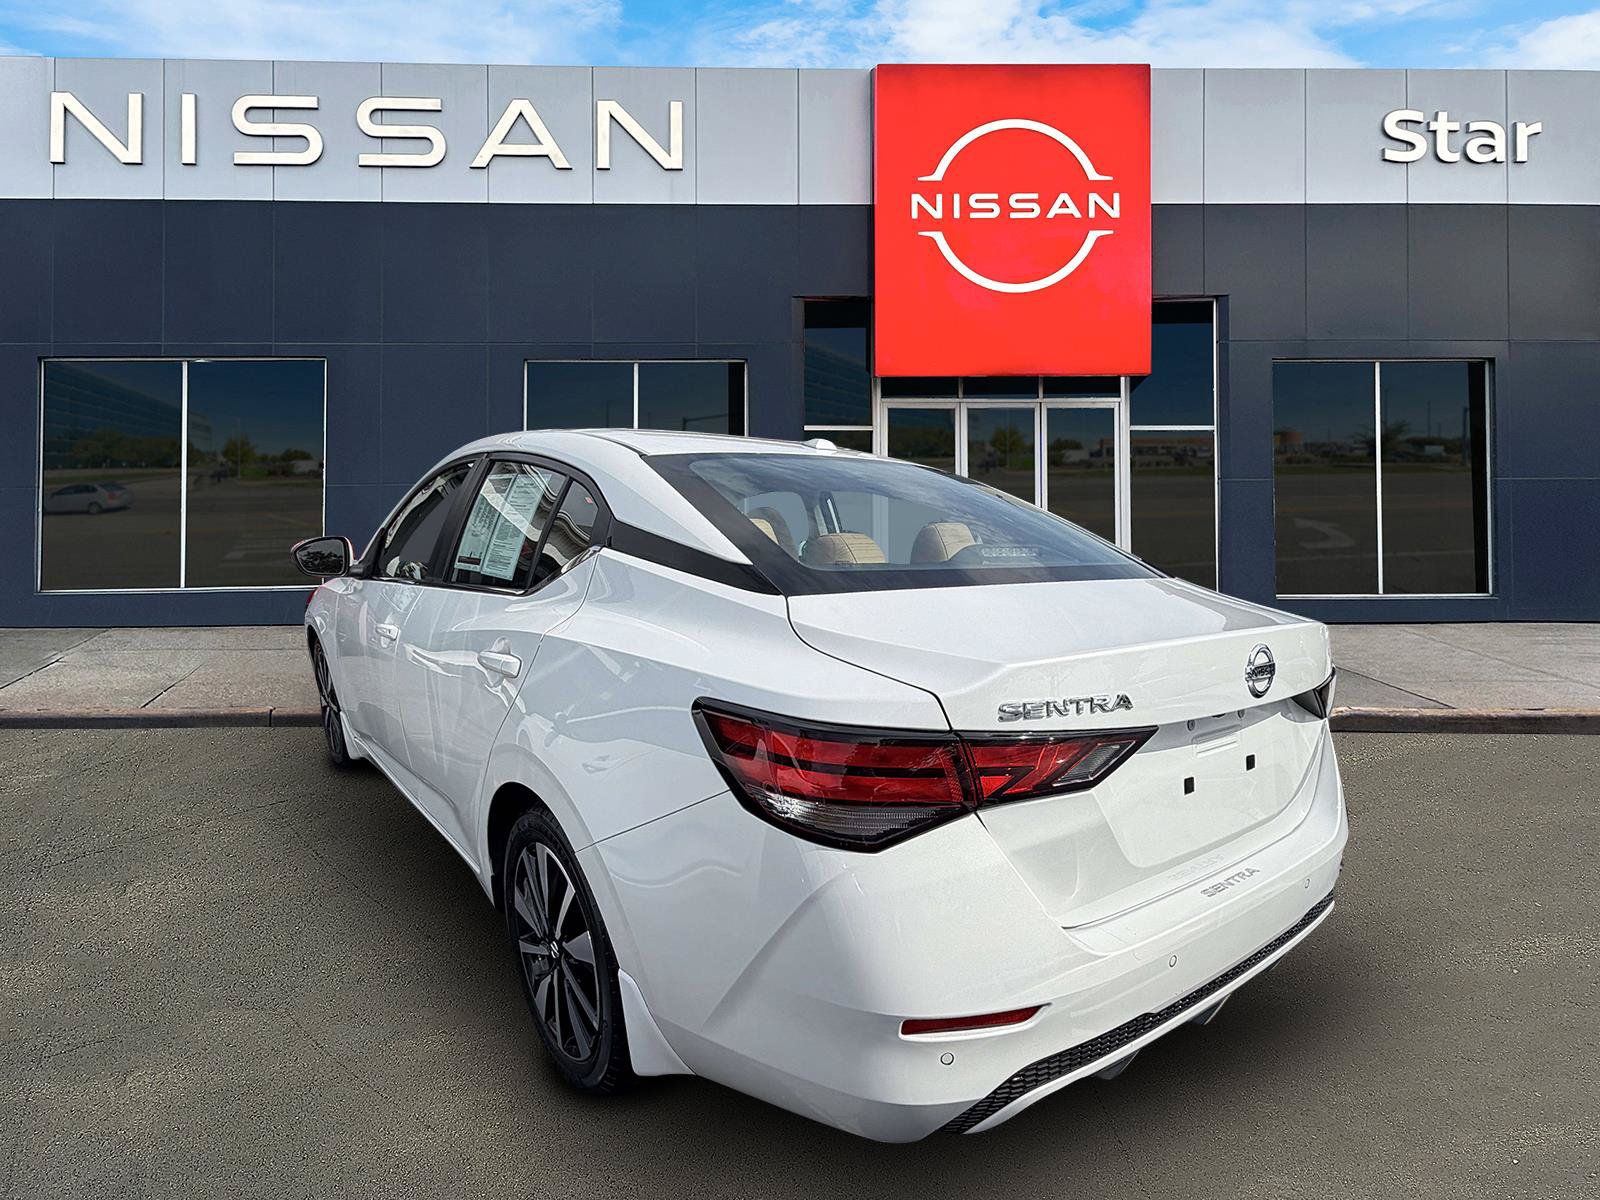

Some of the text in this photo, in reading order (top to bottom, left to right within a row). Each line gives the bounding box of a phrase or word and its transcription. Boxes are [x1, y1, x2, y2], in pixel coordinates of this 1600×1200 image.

[50, 91, 683, 171] NISSAN
[1382, 109, 1542, 163] Star
[911, 193, 1120, 219] NISSAN
[998, 694, 1134, 722] SENTRA
[1200, 867, 1260, 897] SENTRA
